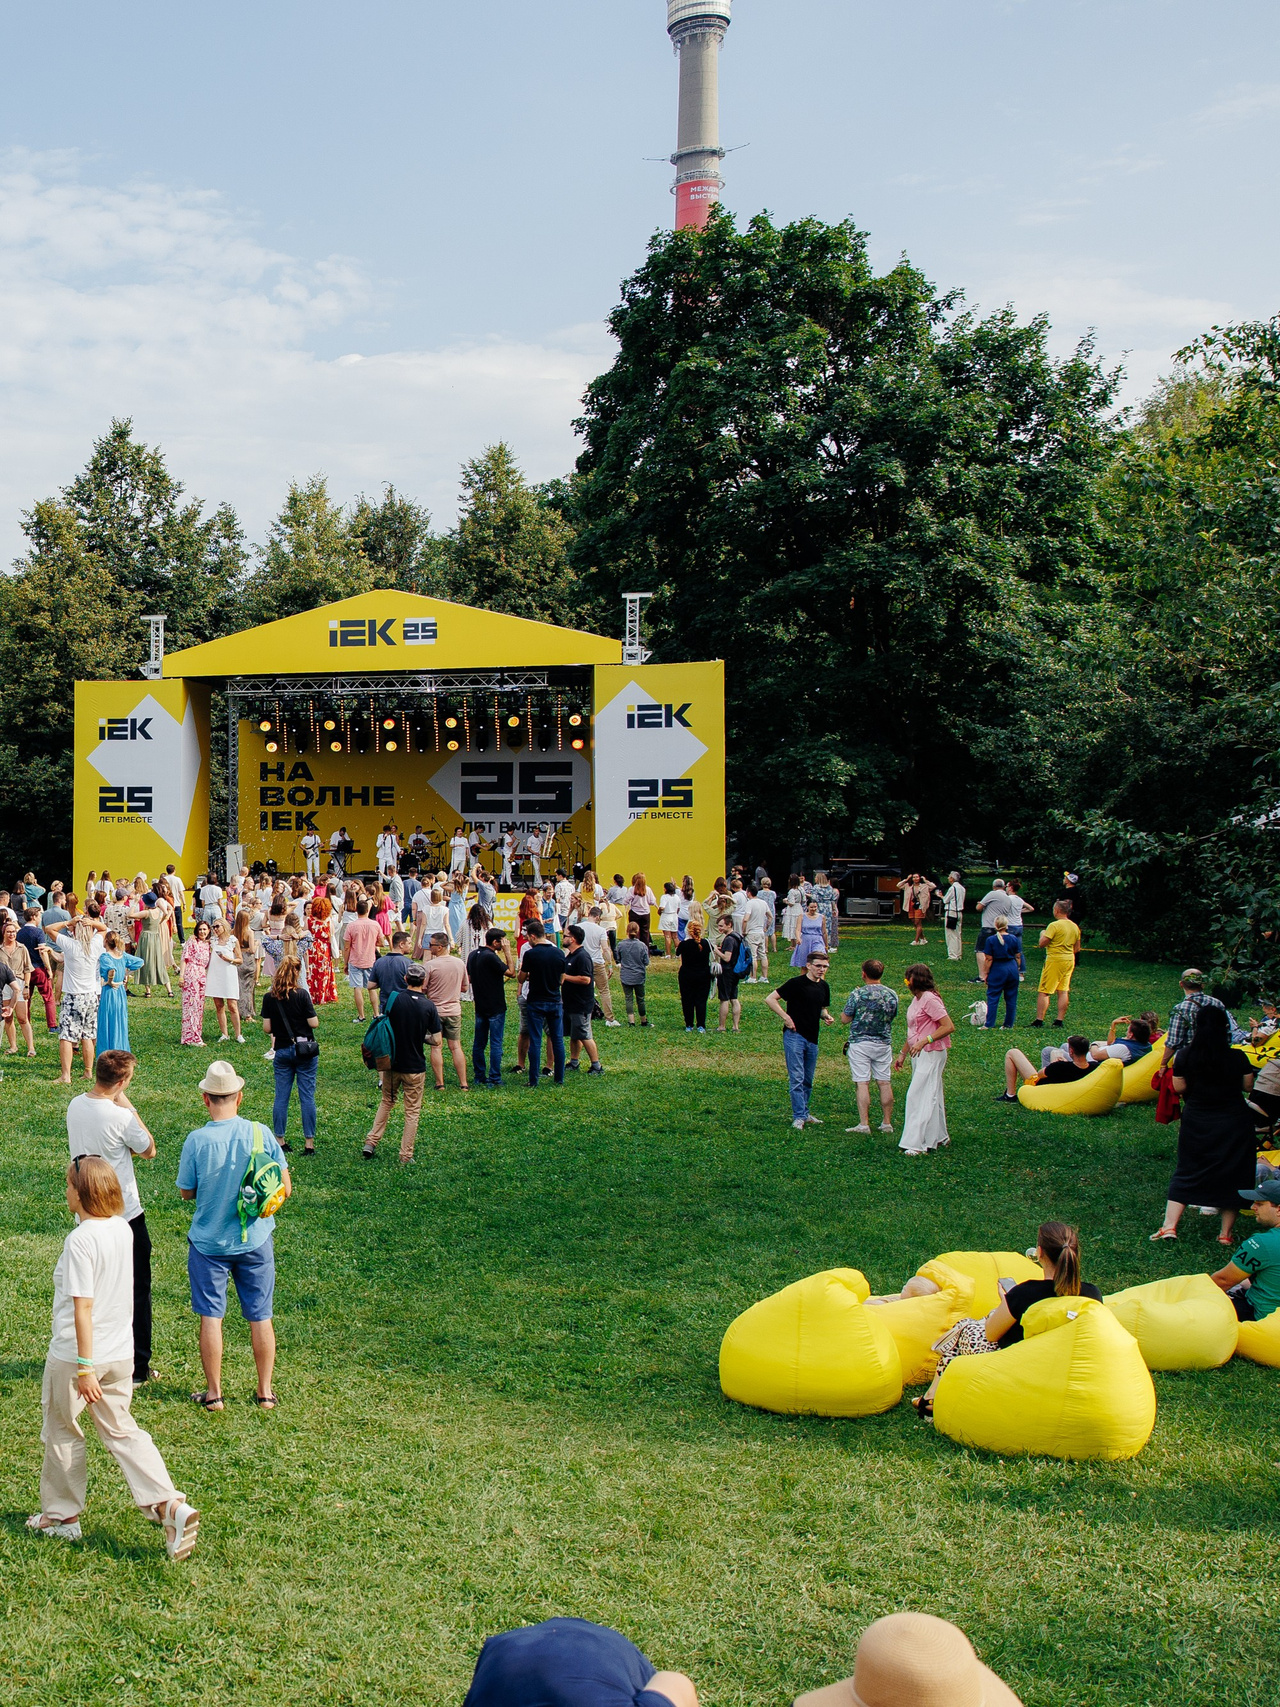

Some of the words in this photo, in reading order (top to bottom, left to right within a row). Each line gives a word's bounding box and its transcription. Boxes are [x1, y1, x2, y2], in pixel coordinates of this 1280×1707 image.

[403, 622, 438, 640] 25
[259, 761, 315, 782] НА
[259, 785, 395, 807] ВОЛНЕ
[460, 761, 573, 814] 25
[627, 778, 693, 808] 25
[98, 786, 153, 813] 25
[259, 811, 320, 831] IEK
[651, 811, 693, 819] ВМЕСТЕ
